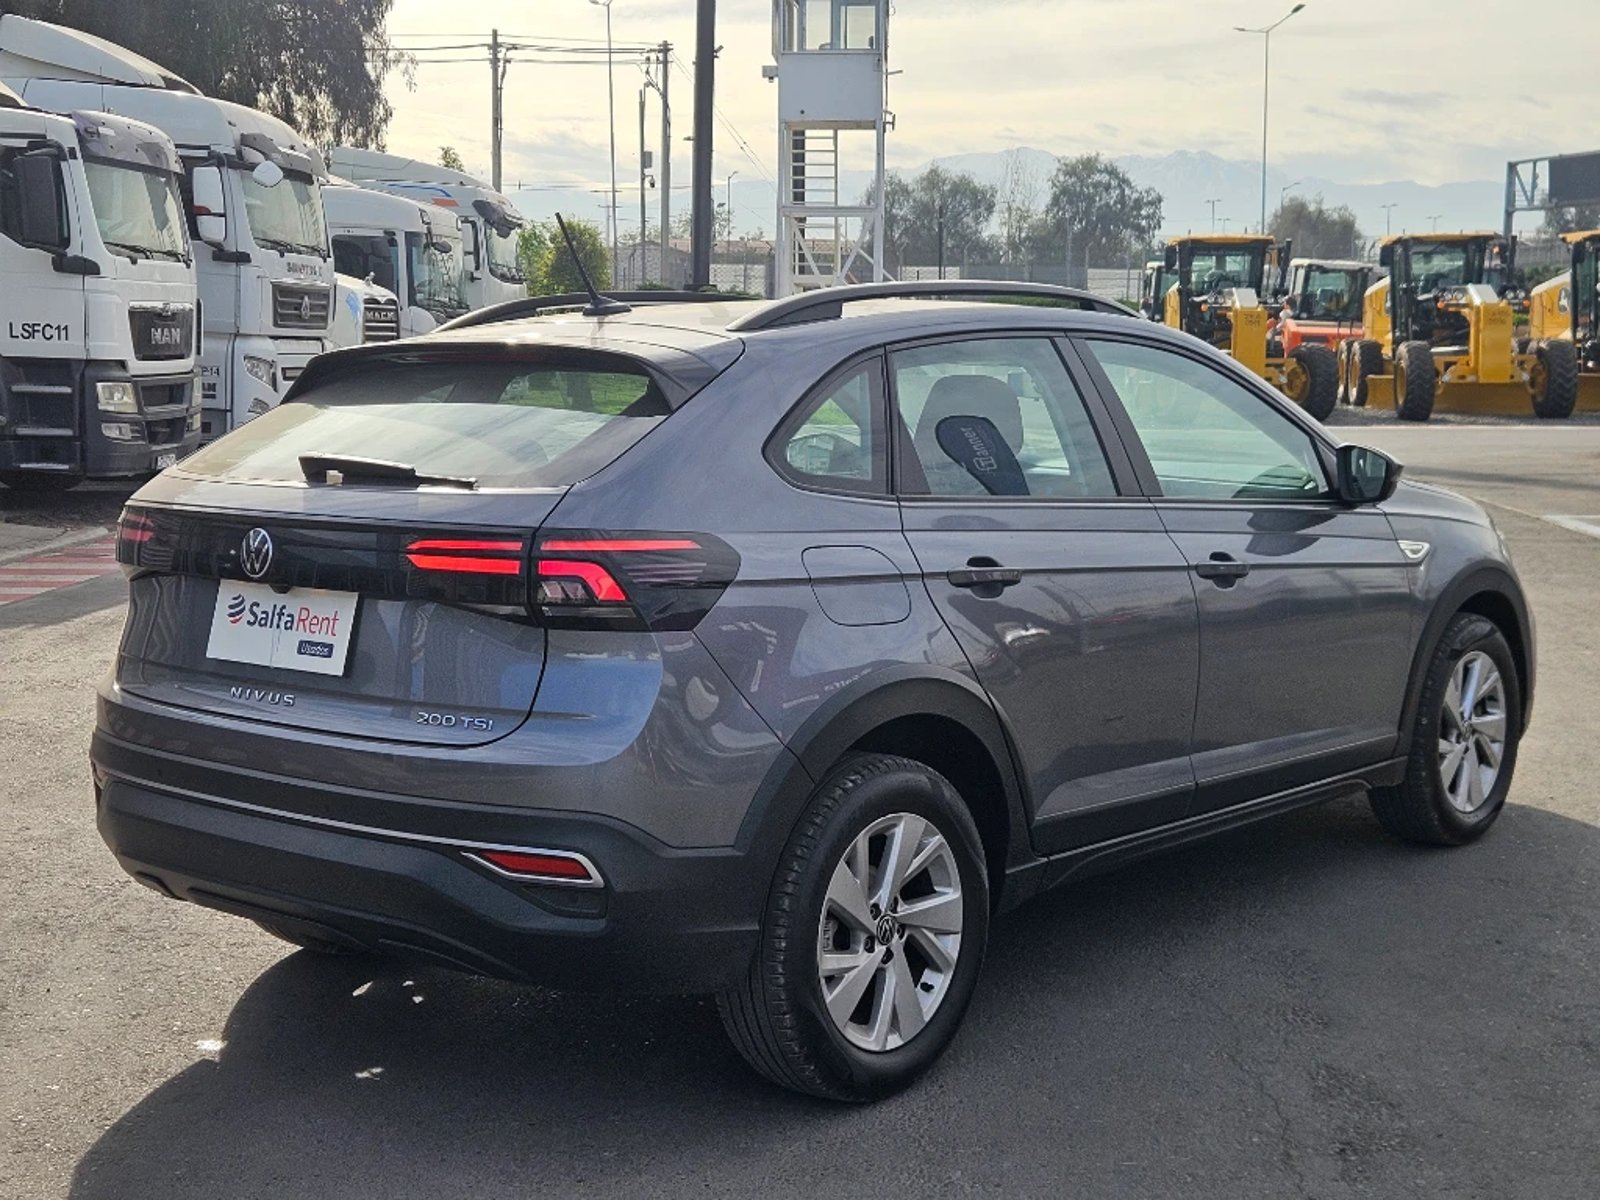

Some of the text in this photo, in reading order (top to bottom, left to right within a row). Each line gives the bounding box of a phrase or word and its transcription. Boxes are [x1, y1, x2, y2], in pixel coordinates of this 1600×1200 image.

[9, 322, 69, 341] LSFC11
[151, 328, 181, 344] MAN
[246, 601, 340, 637] SalfaRent
[230, 685, 296, 707] NIVUS
[416, 711, 494, 731] 200 TSI
